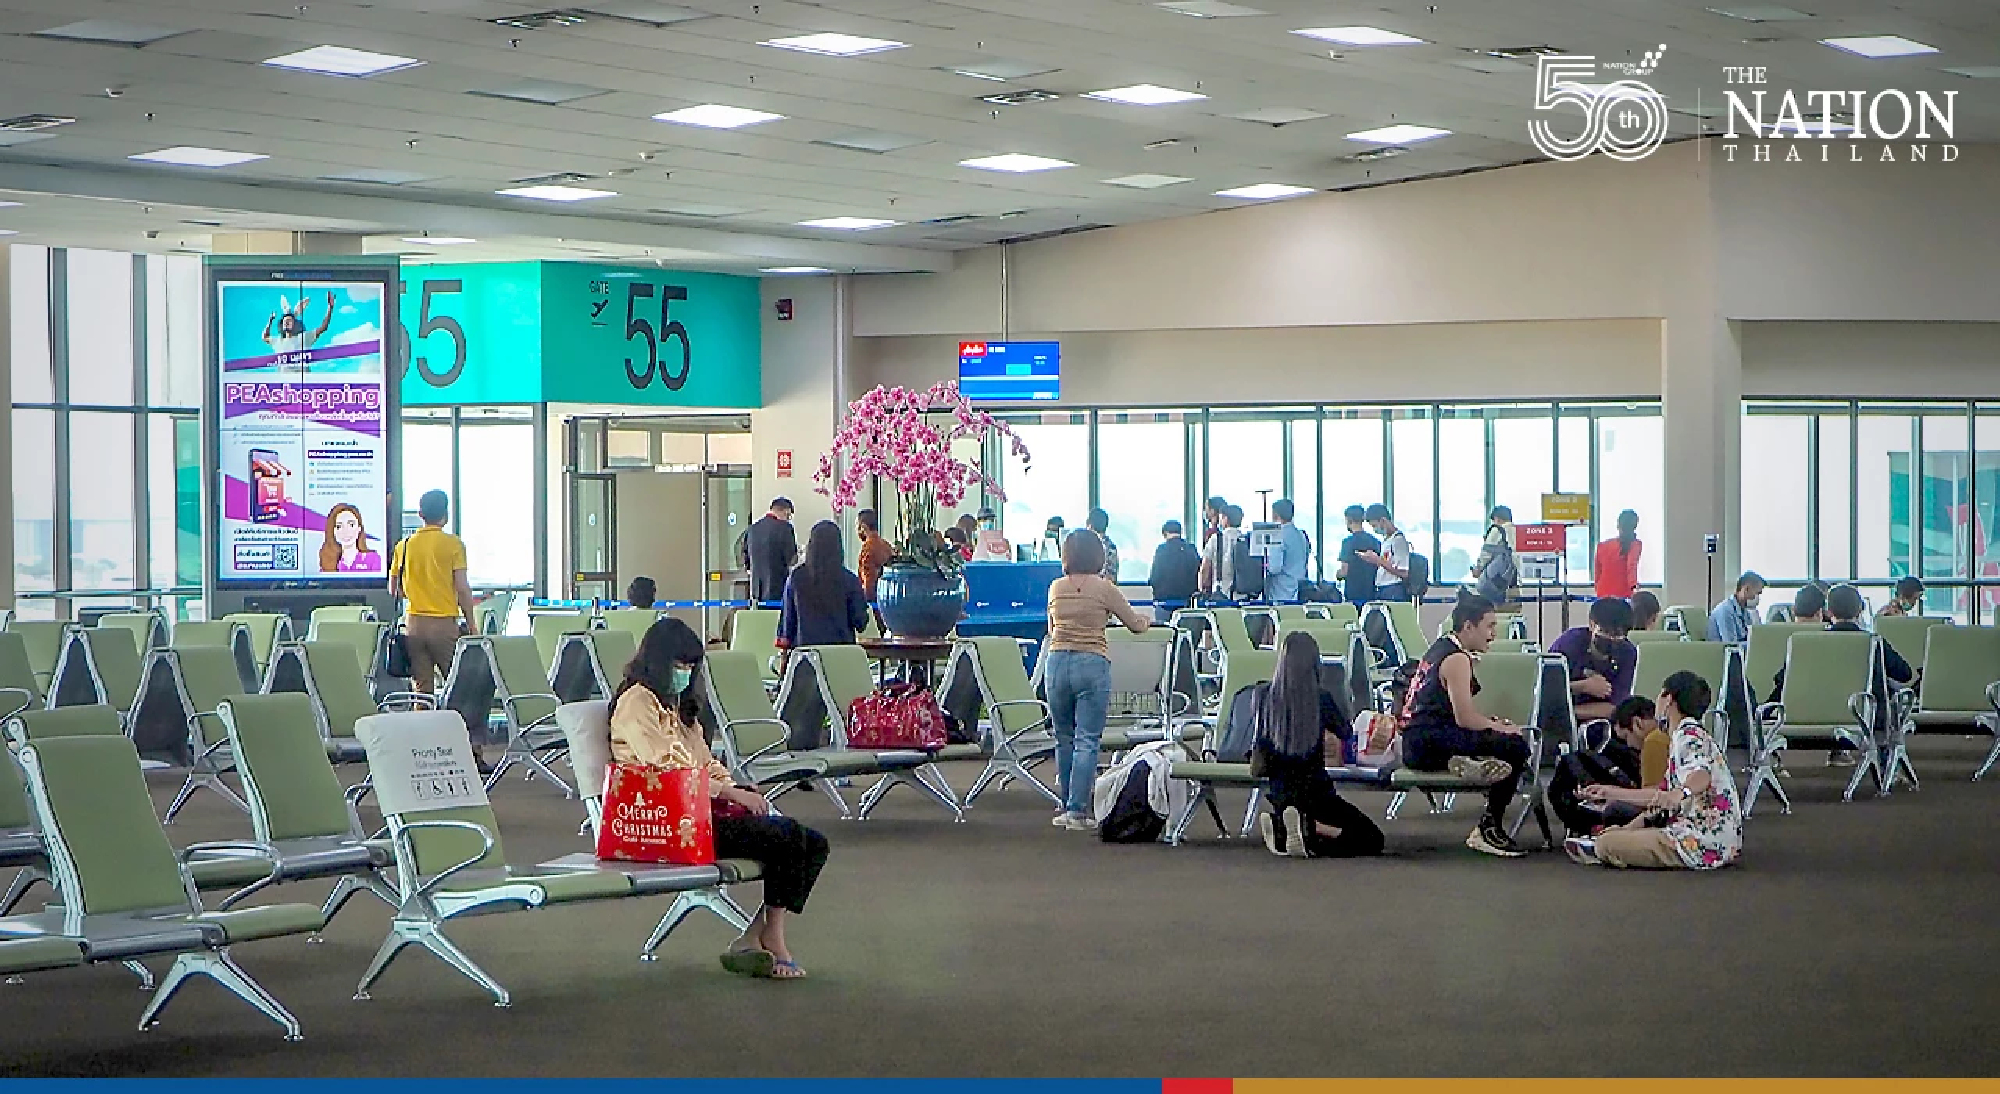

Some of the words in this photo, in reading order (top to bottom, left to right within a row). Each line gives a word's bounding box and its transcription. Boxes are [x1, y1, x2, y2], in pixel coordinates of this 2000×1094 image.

[589, 281, 610, 295] GATE
[624, 282, 690, 391] 55
[226, 384, 379, 408] PEAshopping
[437, 746, 453, 757] Seat
[616, 802, 668, 821] MERRY
[611, 818, 673, 837] CHRISTMAS
